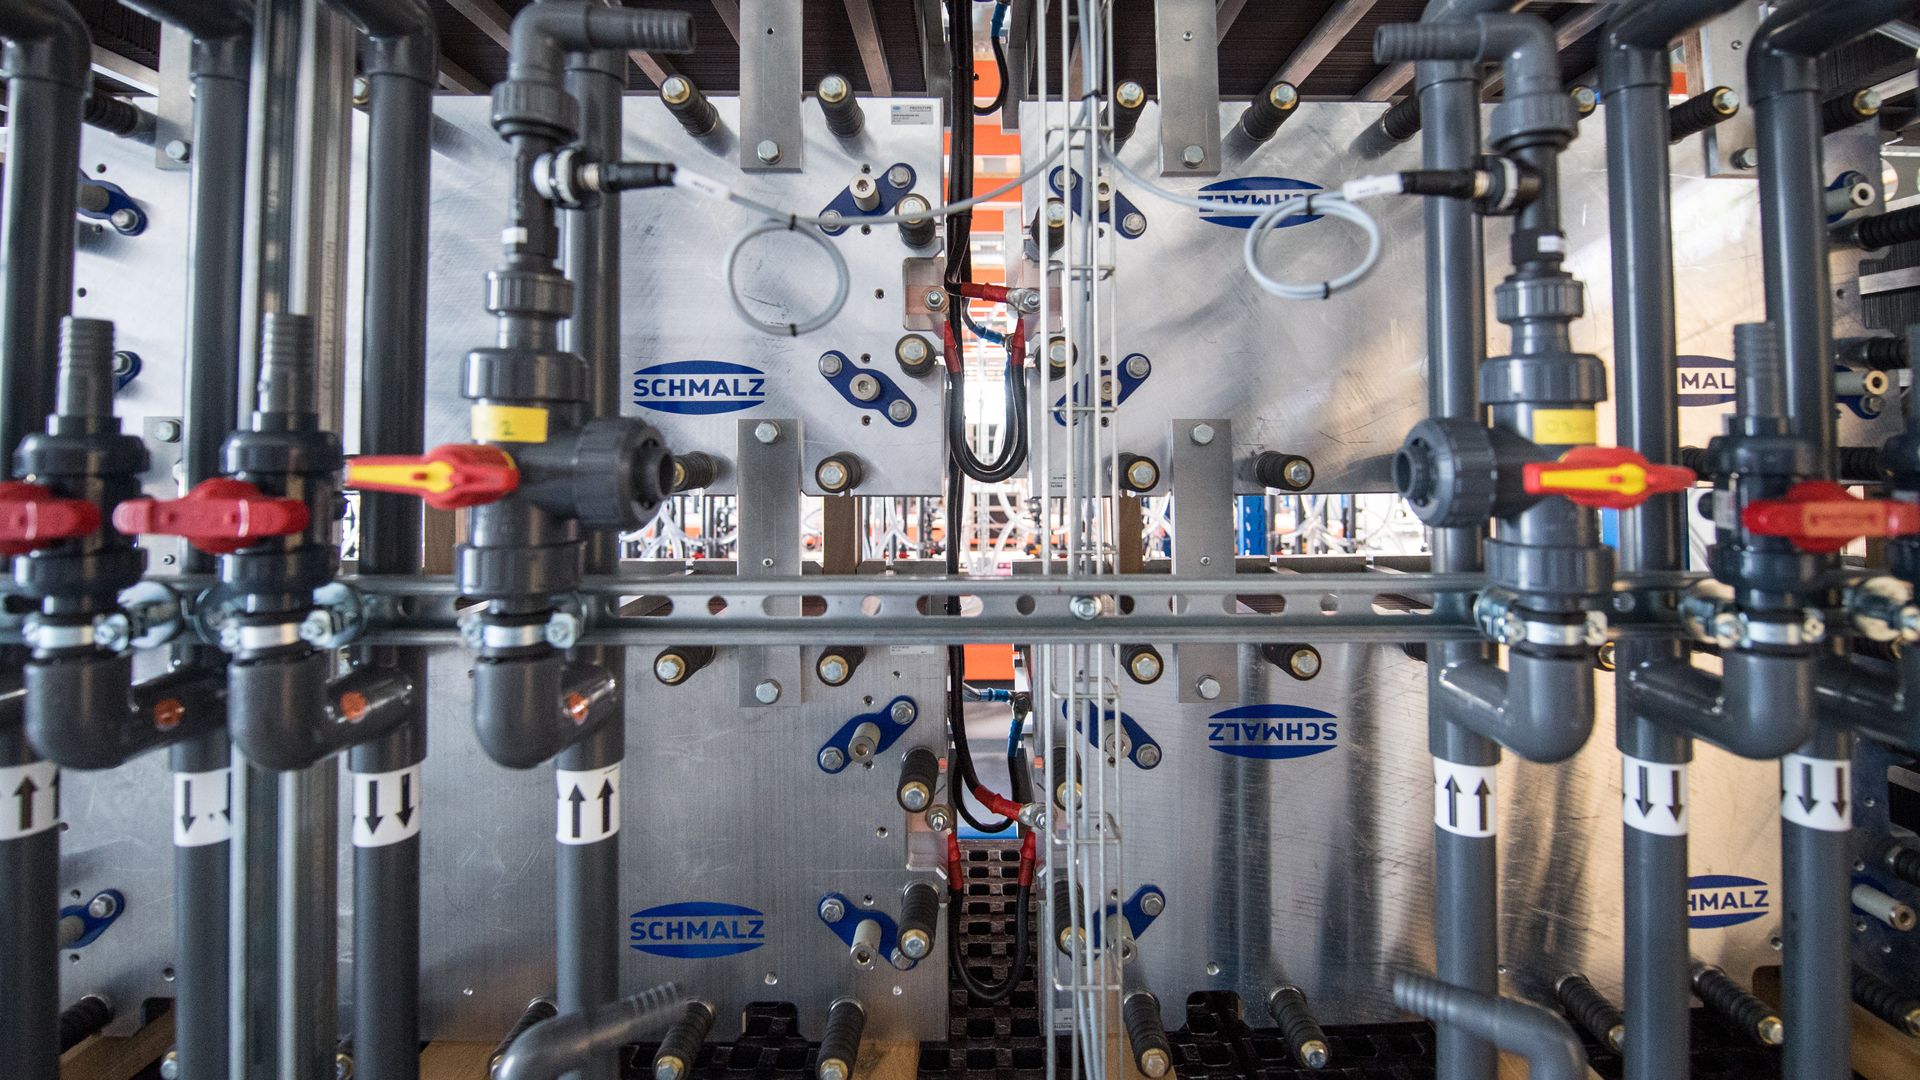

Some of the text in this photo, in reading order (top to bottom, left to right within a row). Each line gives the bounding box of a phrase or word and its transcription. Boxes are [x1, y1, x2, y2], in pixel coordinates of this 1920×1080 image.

[1197, 192, 1322, 213] HMALZ
[632, 378, 766, 397] SCHMALZ
[1207, 722, 1338, 741] SCHMALZ
[1687, 889, 1769, 911] HMALZ
[629, 919, 766, 941] SCHMALZ
